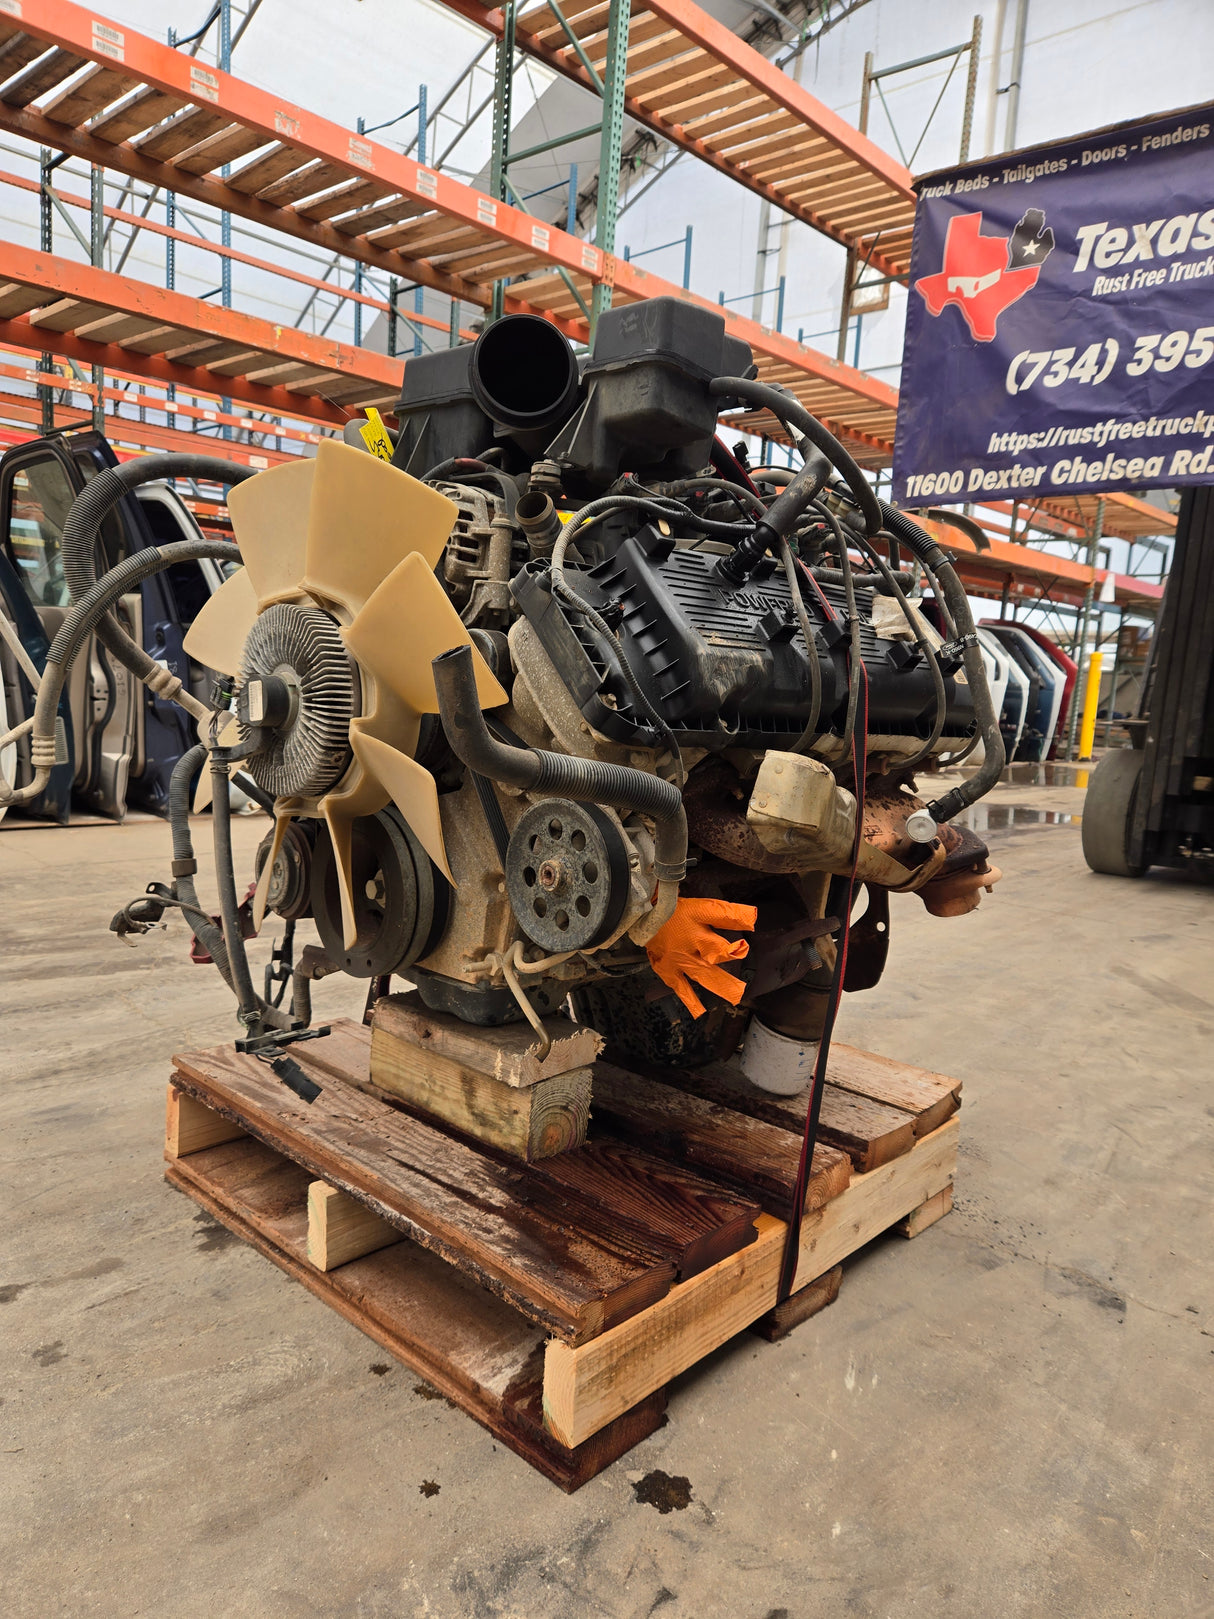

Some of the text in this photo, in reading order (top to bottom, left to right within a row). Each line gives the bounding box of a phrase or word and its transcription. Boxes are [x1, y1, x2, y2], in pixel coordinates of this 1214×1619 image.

[954, 173, 990, 195] Beds
[1002, 158, 1068, 185] Tailgates
[1082, 142, 1127, 165] Doors
[1141, 122, 1211, 152] Fenders
[1091, 273, 1131, 296] Rust
[1130, 263, 1169, 288] Free
[1005, 338, 1119, 395] (734)
[905, 472, 965, 498] 11600
[967, 463, 1047, 492] Dexter
[1050, 453, 1165, 486] Chelsea
